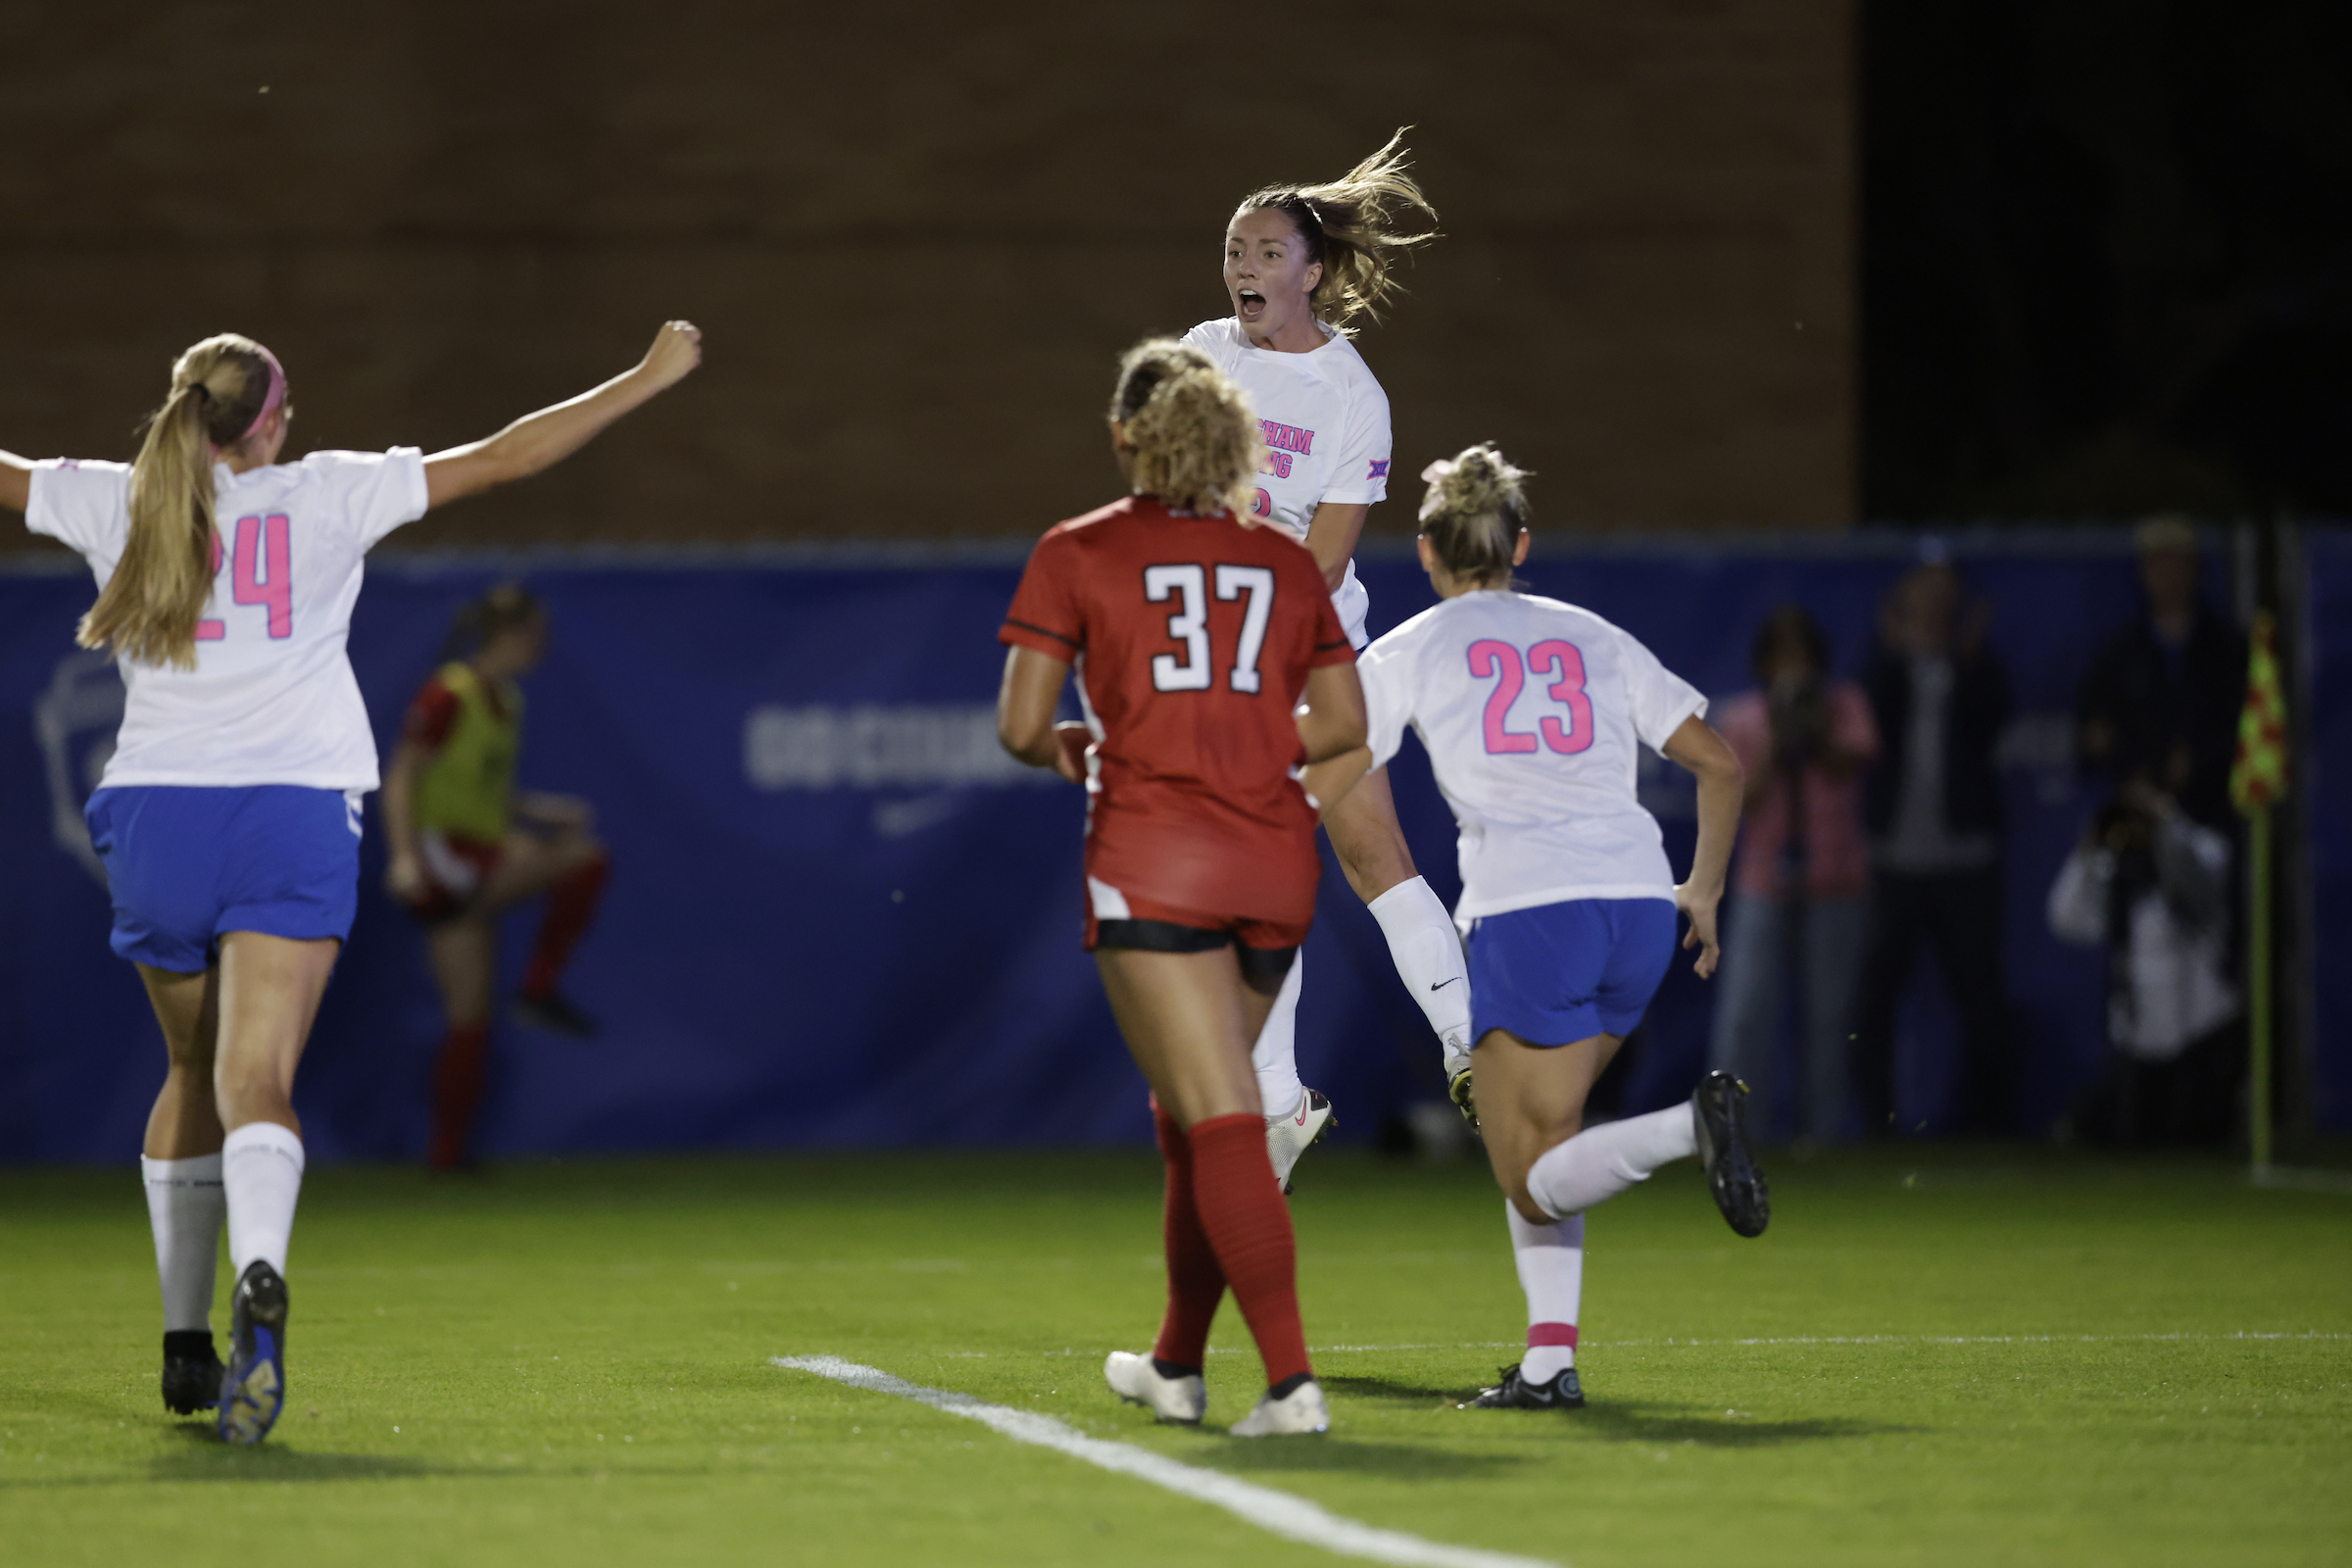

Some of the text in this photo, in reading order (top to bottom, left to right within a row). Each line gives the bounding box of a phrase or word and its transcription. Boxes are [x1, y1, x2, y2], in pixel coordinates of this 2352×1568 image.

[1258, 450, 1294, 479] NG
[1143, 562, 1275, 695] 37
[1466, 638, 1594, 756] 23
